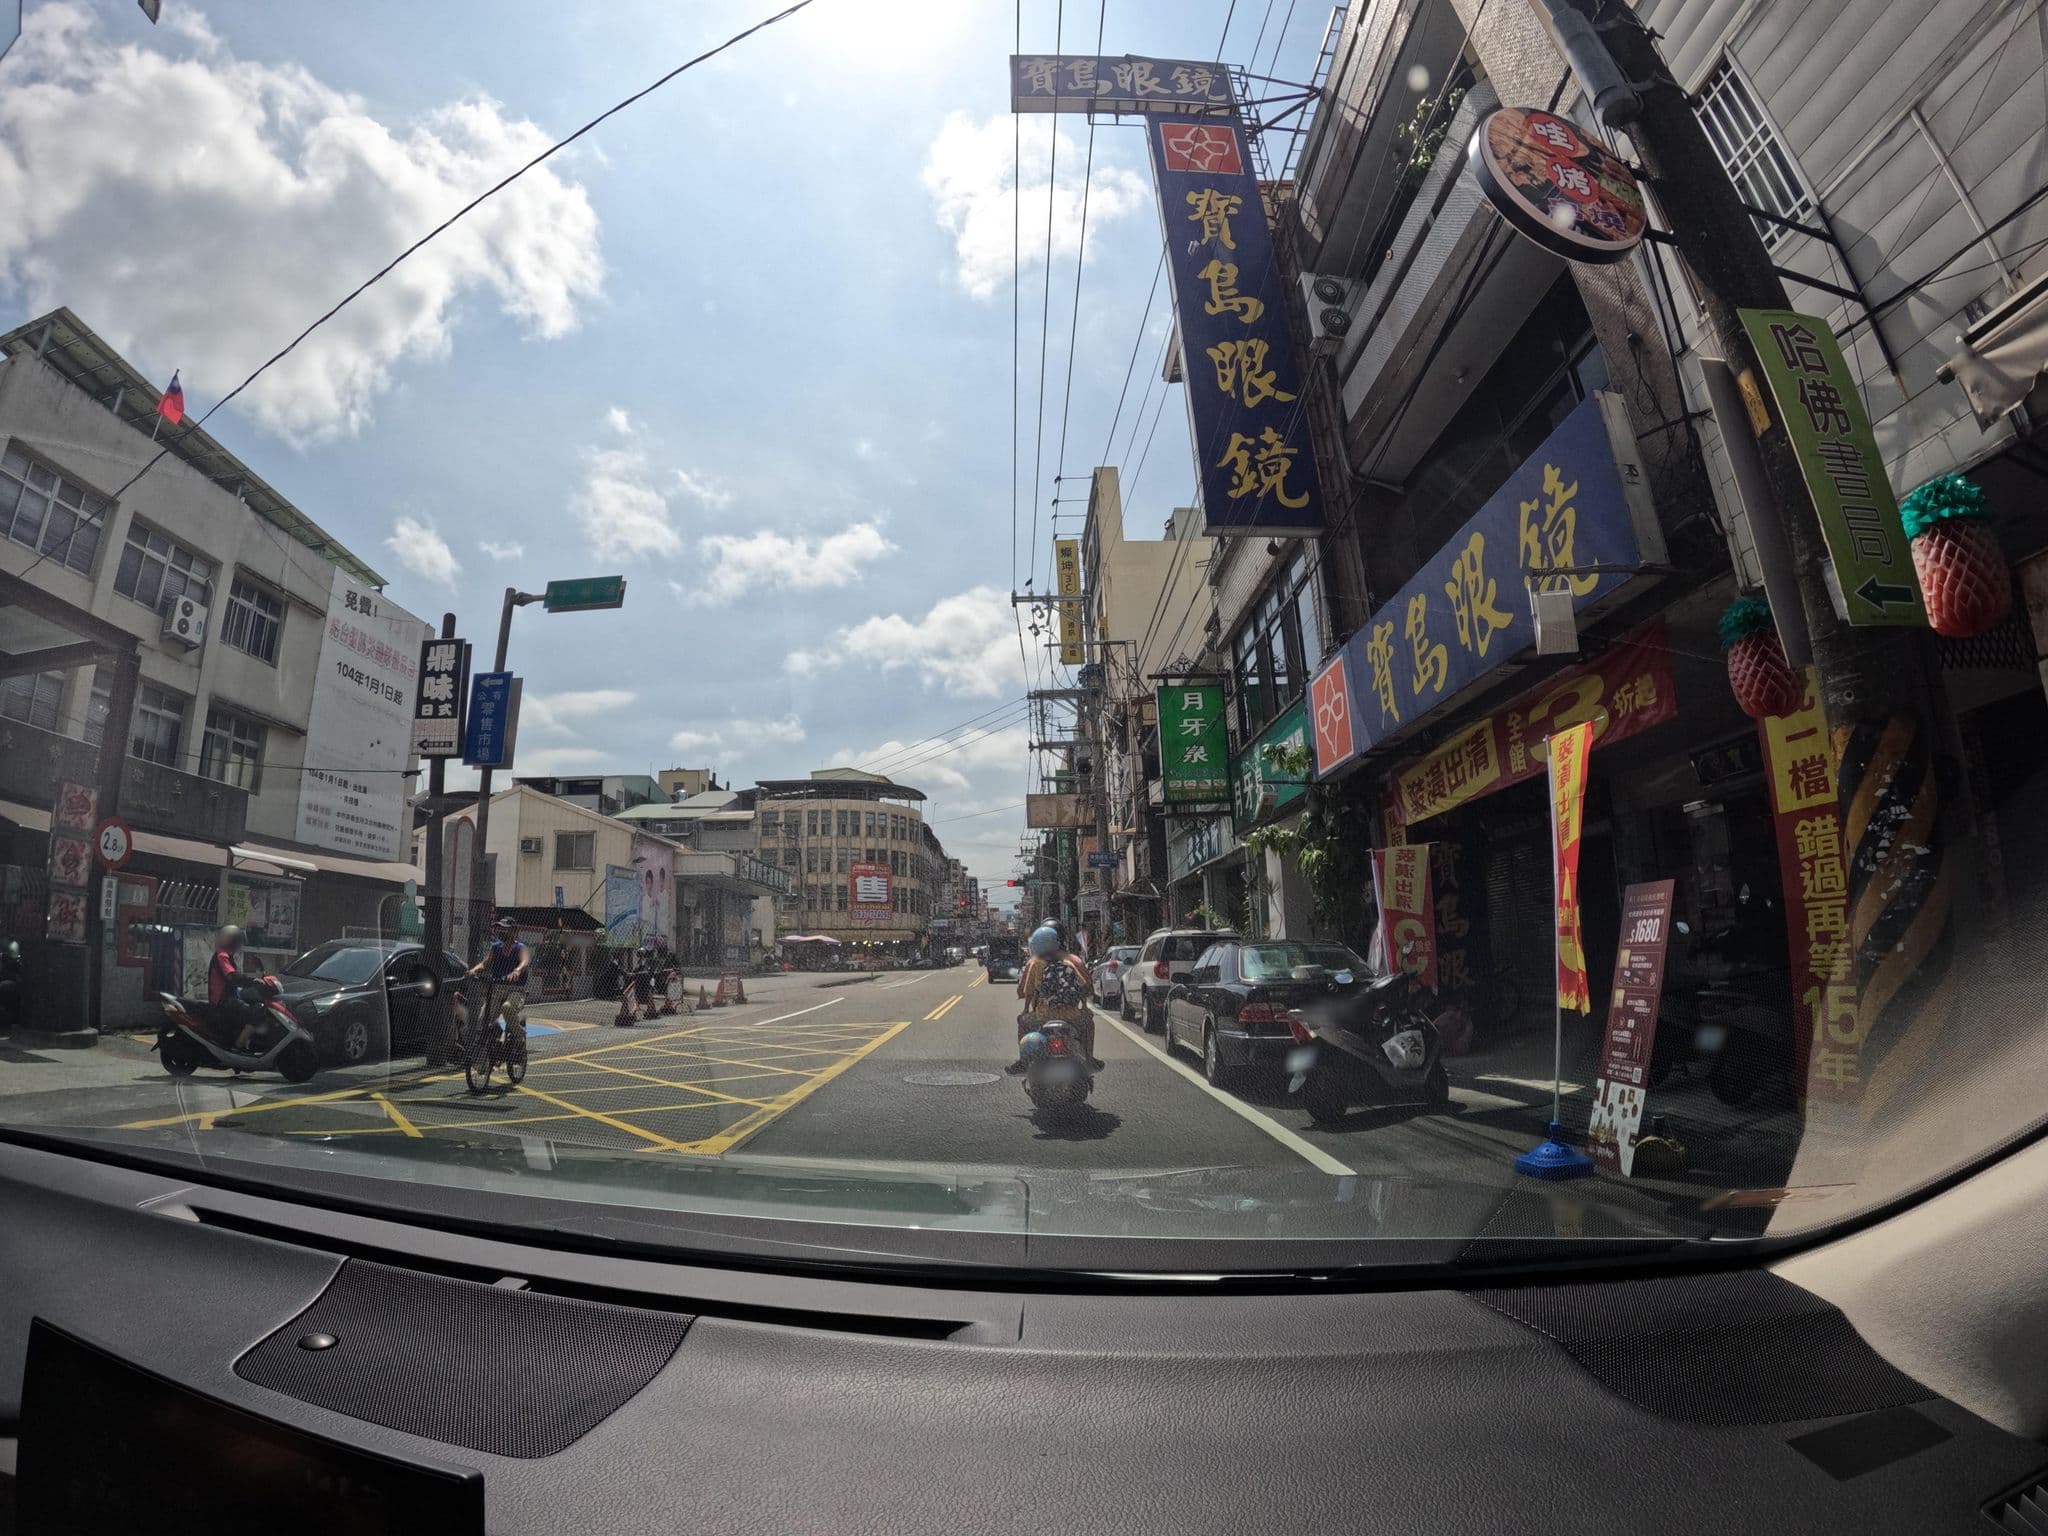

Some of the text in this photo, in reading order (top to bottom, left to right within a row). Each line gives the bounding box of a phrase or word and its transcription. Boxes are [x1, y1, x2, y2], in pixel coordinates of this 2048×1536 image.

[1018, 57, 1228, 102] 寶島眼鏡
[1532, 120, 1591, 197] 哇烤
[1186, 188, 1310, 509] 寶島眼鏡
[1769, 322, 1893, 567] 哈佛書局
[1367, 462, 1600, 728] 寶島眼鏡
[336, 661, 404, 706] 104年1月1日起
[422, 643, 456, 702] 鼎味
[421, 703, 453, 717] 日式
[1179, 692, 1209, 764] 月牙泉
[1506, 711, 1528, 774] 全館
[1528, 675, 1610, 764] 3
[856, 876, 888, 903] 售
[1629, 918, 1661, 943] $1680
[1795, 814, 1861, 1090] 錯過再等15年
